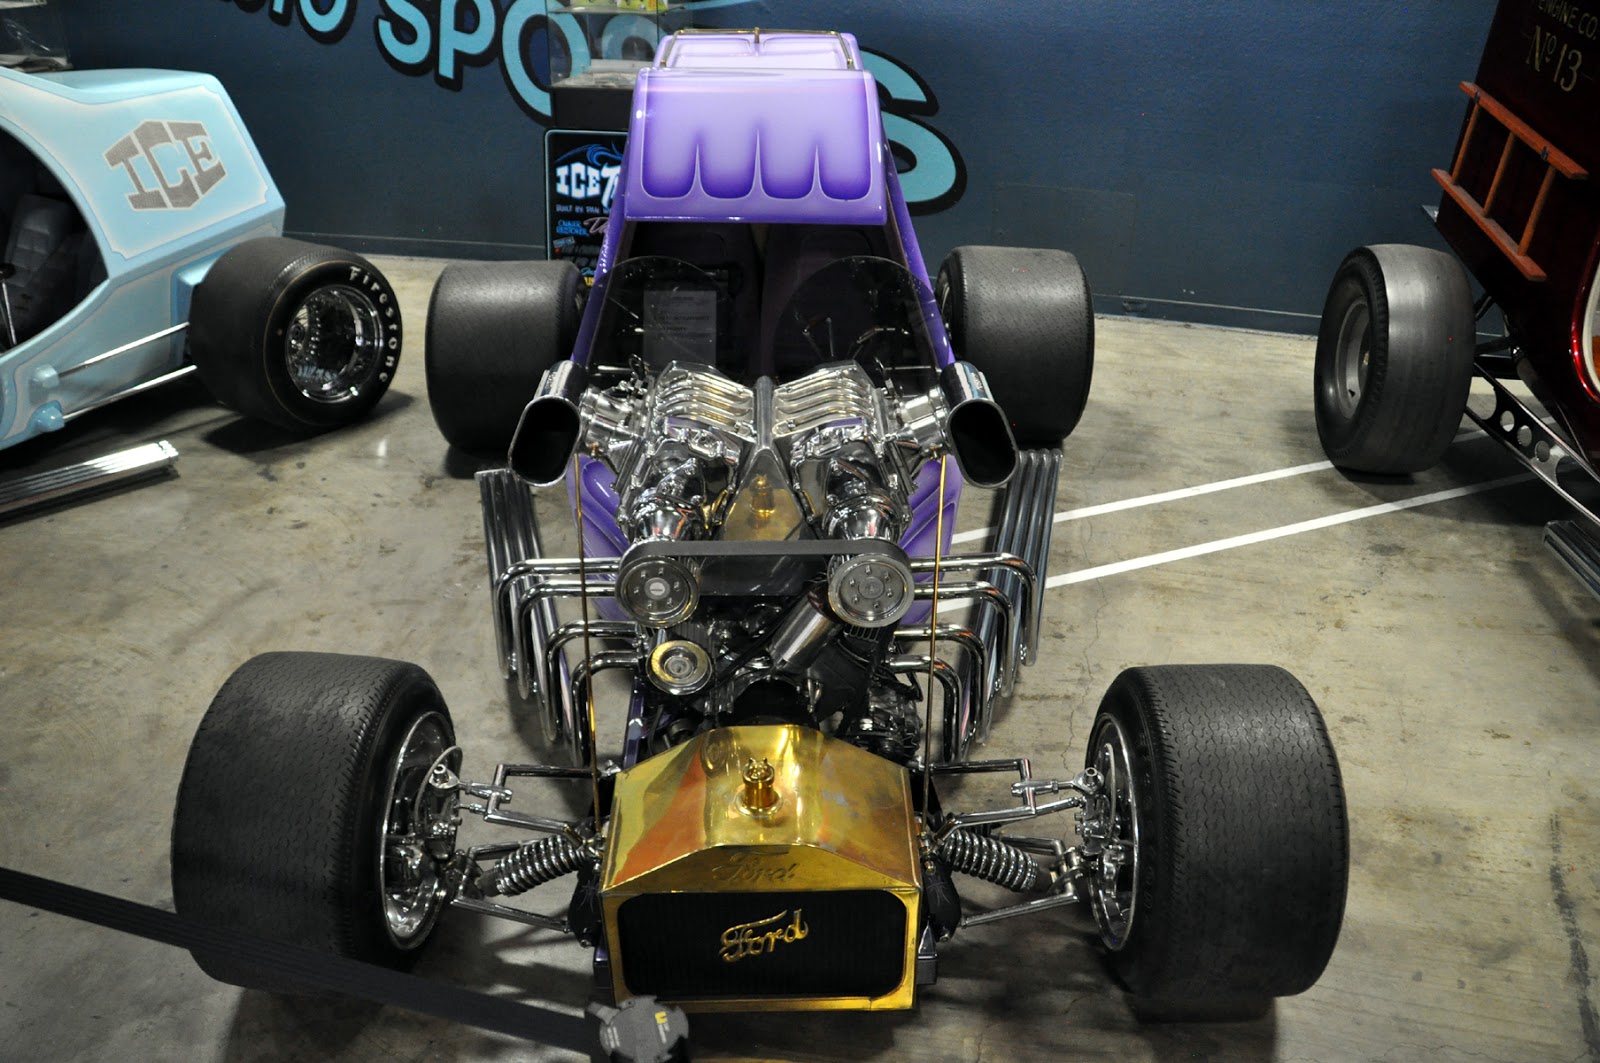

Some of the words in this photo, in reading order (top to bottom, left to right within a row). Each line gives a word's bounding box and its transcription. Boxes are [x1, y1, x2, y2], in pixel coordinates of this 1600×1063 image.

[1553, 43, 1583, 92] 13
[102, 119, 228, 211] ICE
[555, 162, 601, 199] ICE
[349, 265, 398, 383] Firestone
[718, 908, 809, 963] Ford
